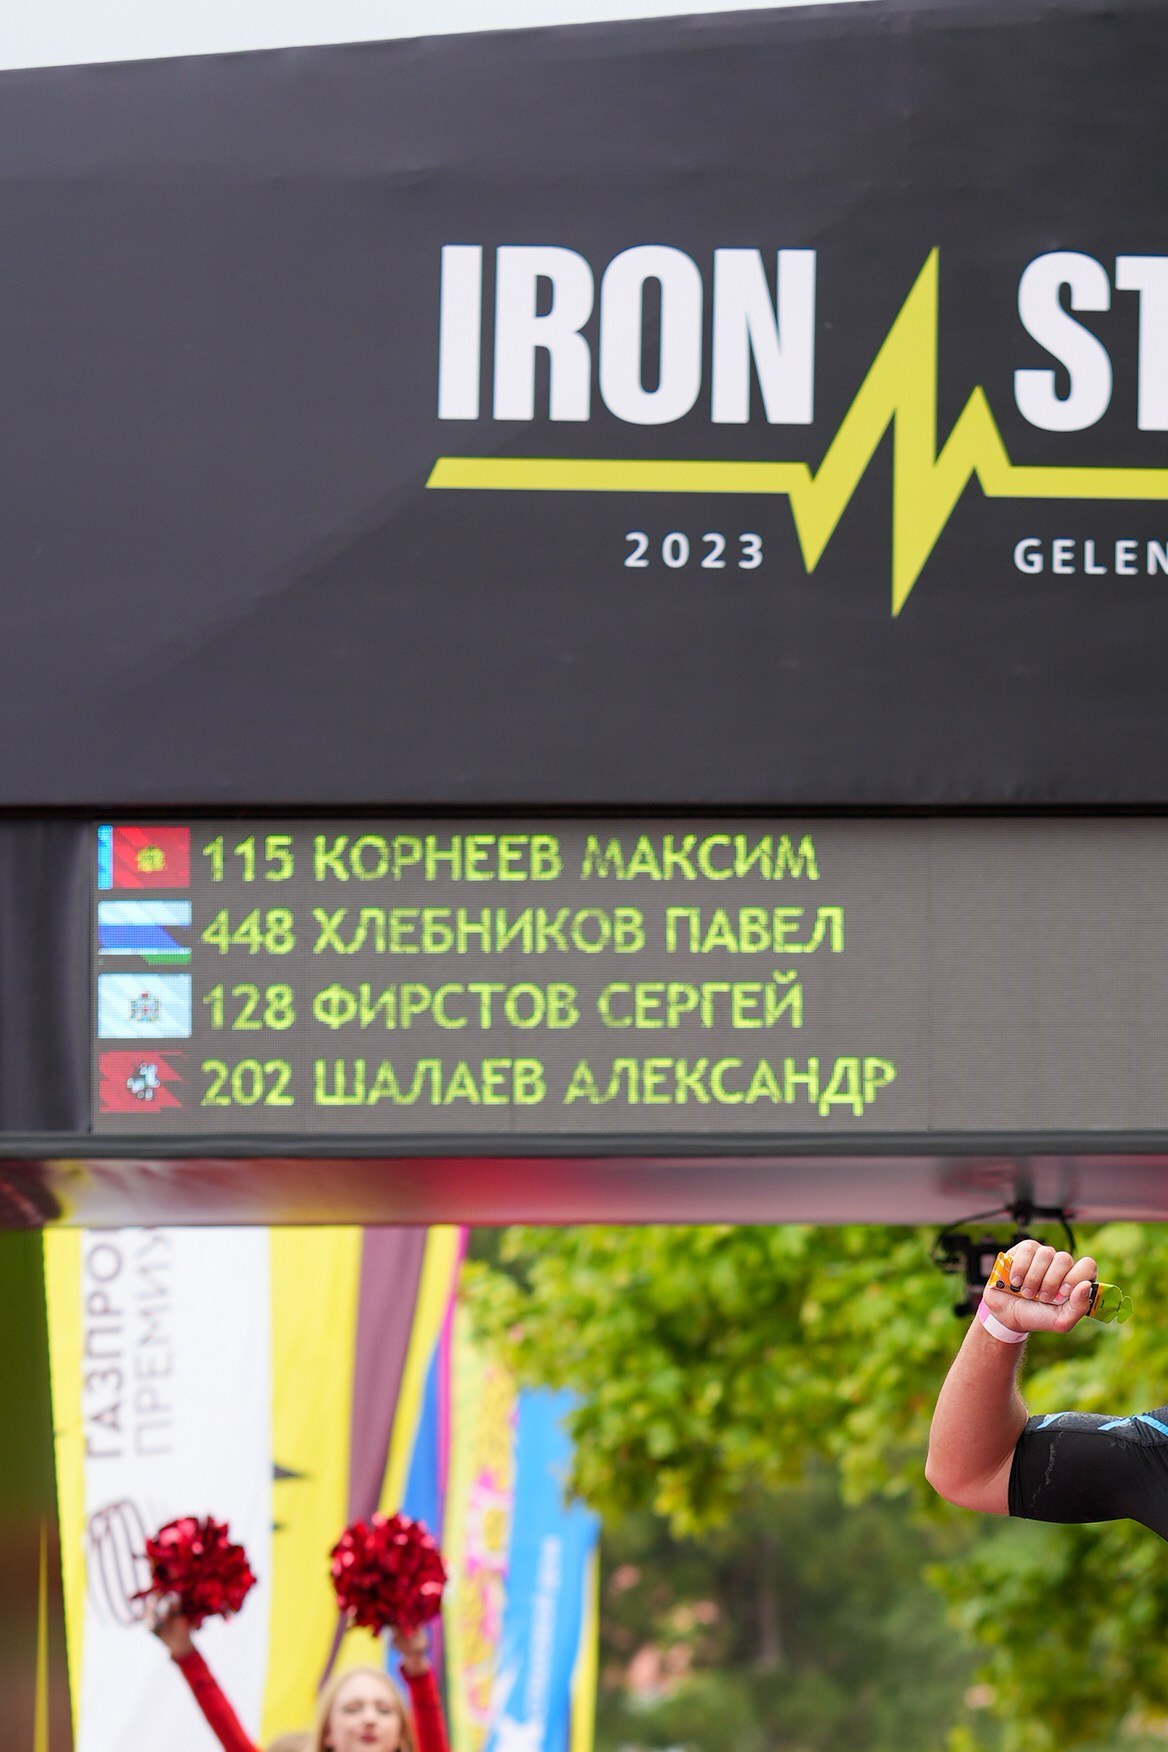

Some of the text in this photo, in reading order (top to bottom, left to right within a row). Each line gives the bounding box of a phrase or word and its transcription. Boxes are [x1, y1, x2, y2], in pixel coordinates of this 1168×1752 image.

[437, 244, 816, 425] IRON
[624, 531, 764, 569] 2023
[202, 835, 294, 882] 115
[313, 834, 564, 881] КОРНЕЕВ
[580, 834, 820, 880] МАКСИМ
[202, 908, 295, 954] 448
[312, 907, 646, 954] ХЛЕБНИКОВ
[665, 906, 844, 953] ПАВЕЛ
[202, 984, 296, 1030] 128
[312, 983, 580, 1029] ФИРСТОВ
[597, 969, 803, 1028] СЕРГЕЙ
[201, 1059, 294, 1106] 202
[314, 1058, 546, 1105] ШАЛАЕВ
[563, 1057, 897, 1116] АЛЕКСАНДР
[85, 1228, 124, 1459] ГАЗПРО
